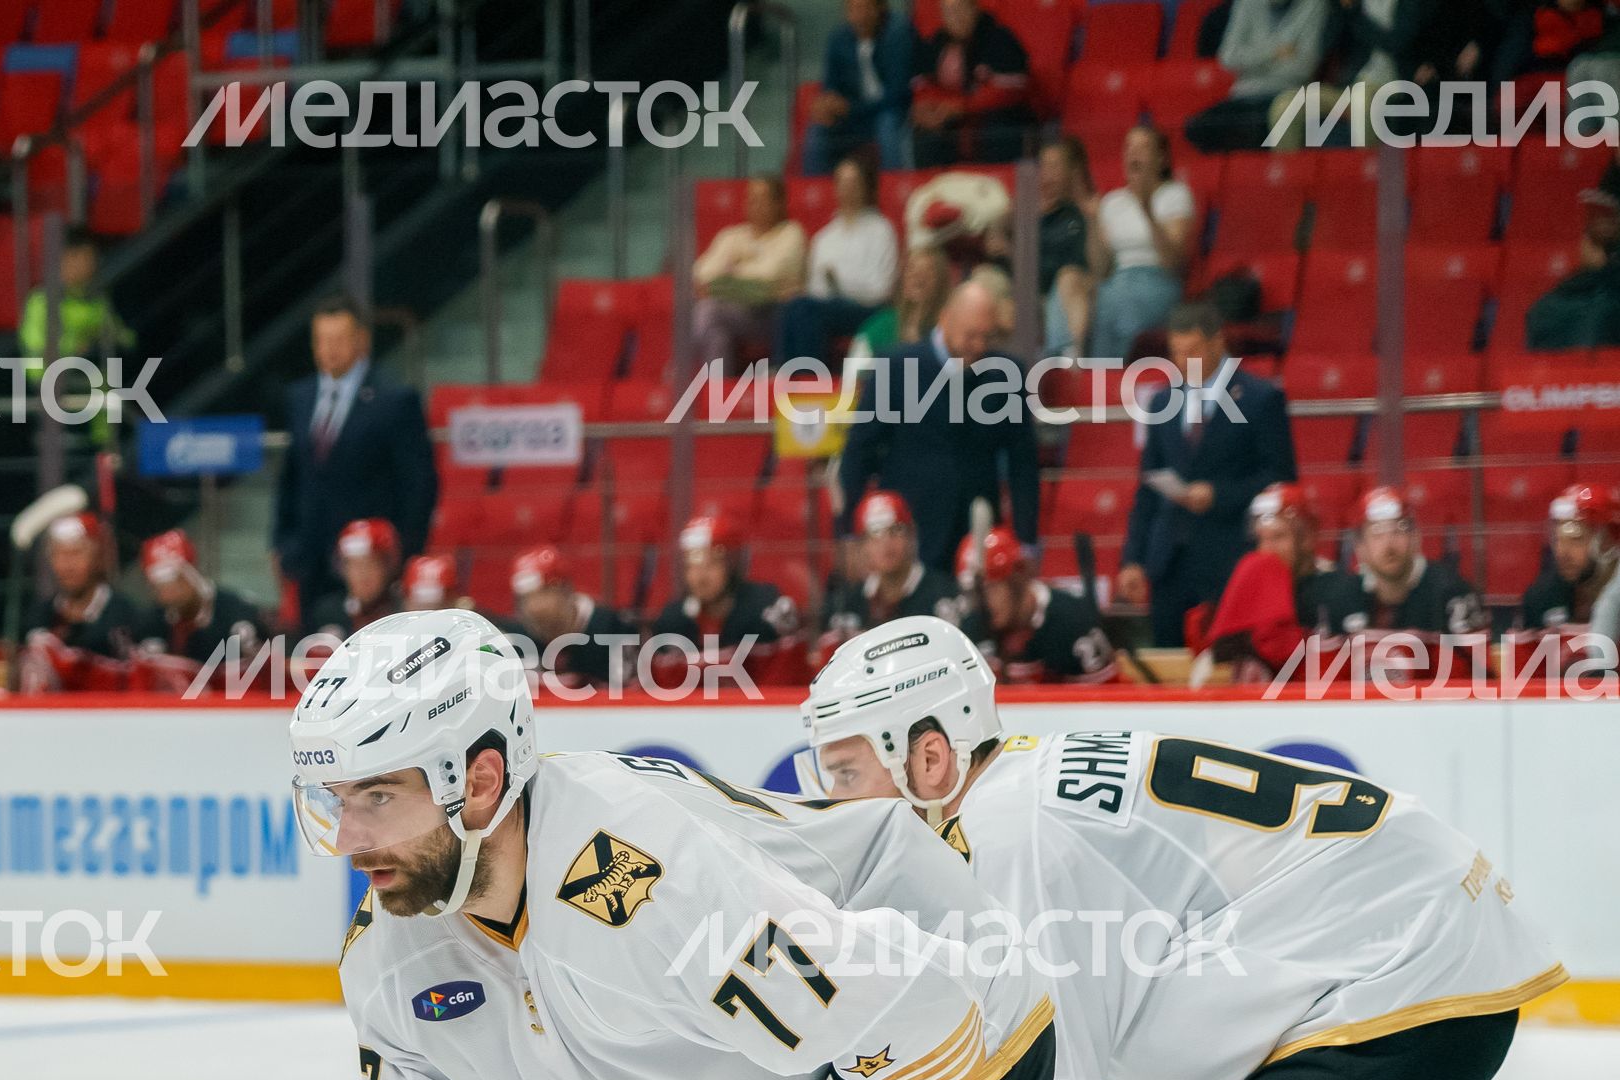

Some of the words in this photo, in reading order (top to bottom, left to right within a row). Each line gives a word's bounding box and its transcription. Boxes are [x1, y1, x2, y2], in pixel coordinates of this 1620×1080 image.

[392, 641, 446, 681] OLIMPBET
[304, 676, 348, 709] 77
[894, 666, 949, 693] BAUER
[427, 686, 473, 720] BAUER
[292, 749, 336, 767] согаз
[445, 801, 466, 813] CCM
[448, 991, 475, 1005] сбп
[711, 918, 841, 1052] 77
